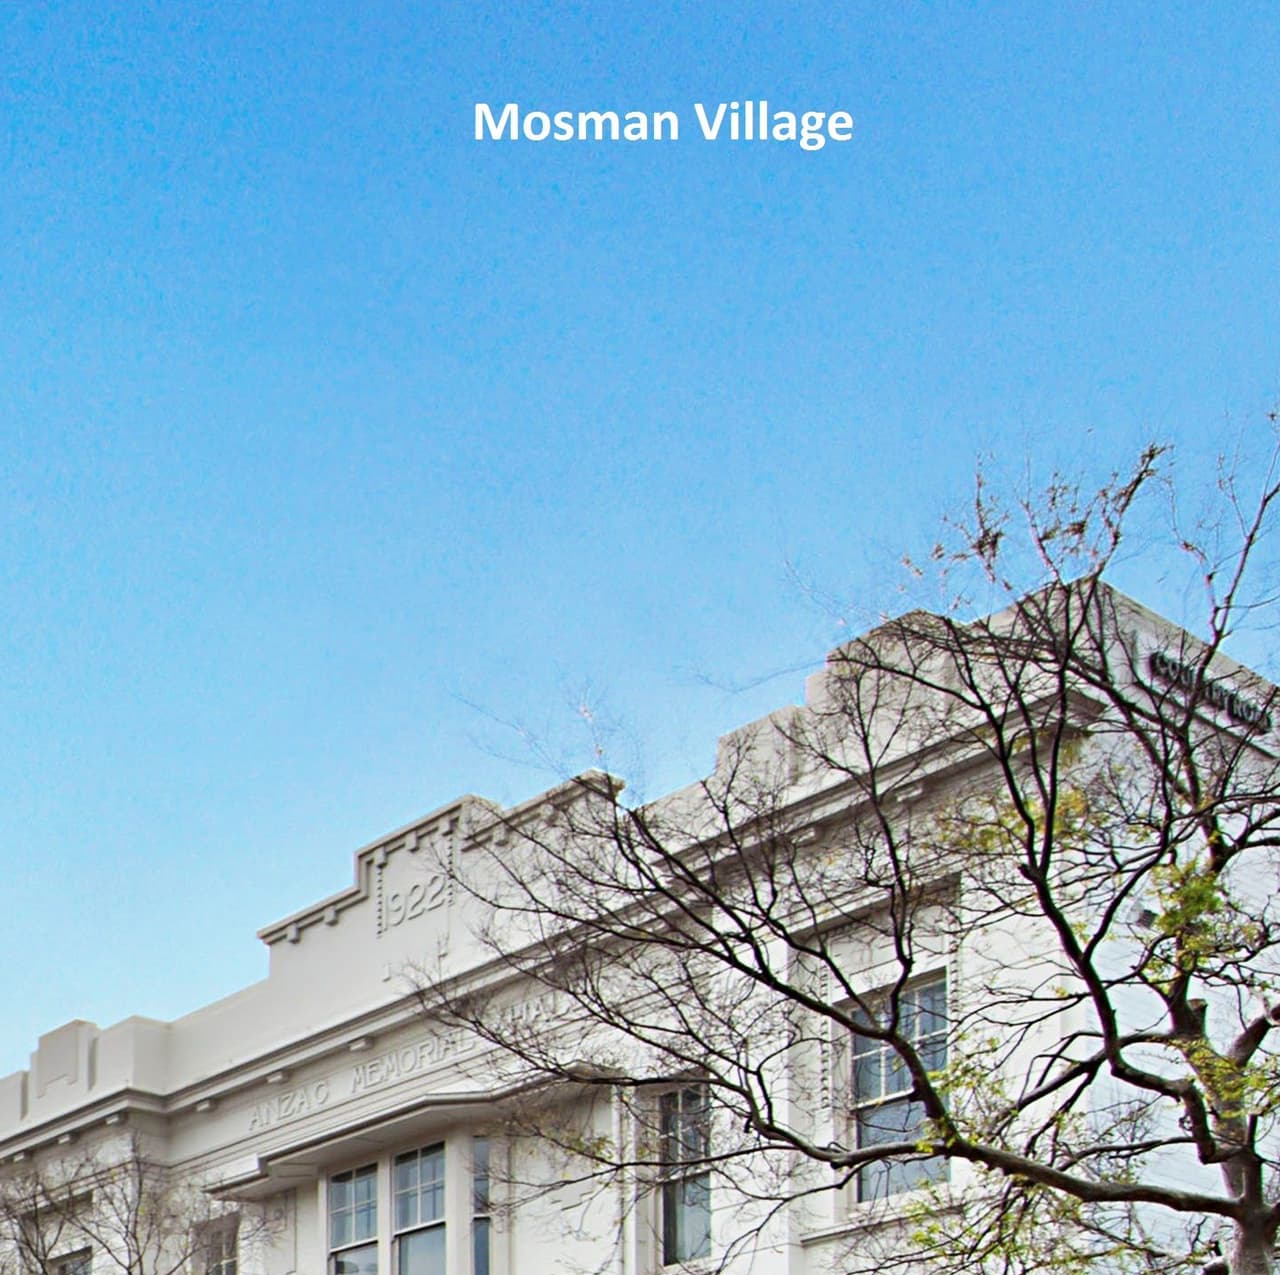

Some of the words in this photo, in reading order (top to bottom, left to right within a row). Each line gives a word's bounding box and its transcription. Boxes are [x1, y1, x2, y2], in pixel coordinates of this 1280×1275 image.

[384, 875, 446, 932] 1922
[248, 1080, 330, 1131] ANZAC
[351, 1027, 476, 1094] MEMORIAL
